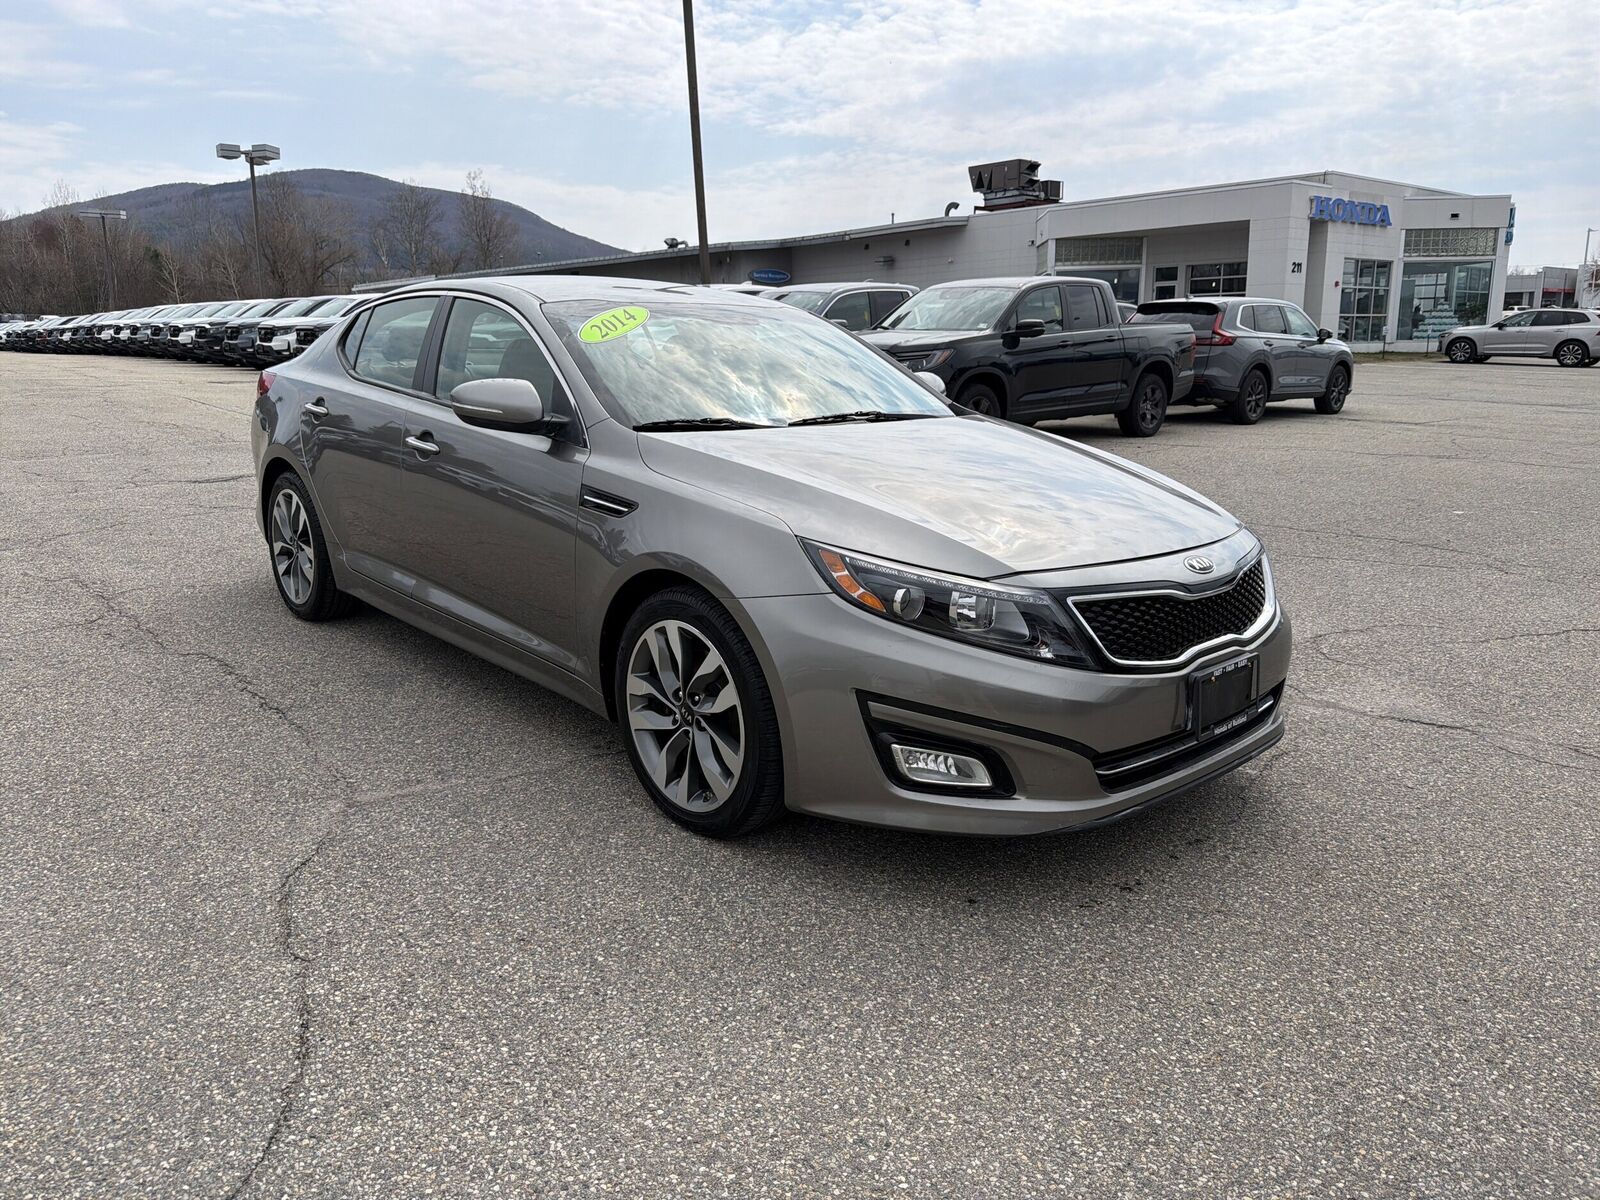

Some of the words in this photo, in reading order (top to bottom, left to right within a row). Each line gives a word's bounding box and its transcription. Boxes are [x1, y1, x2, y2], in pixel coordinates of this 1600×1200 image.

[1309, 195, 1392, 226] HONDA
[1291, 262, 1302, 273] 211
[590, 309, 637, 338] 2014
